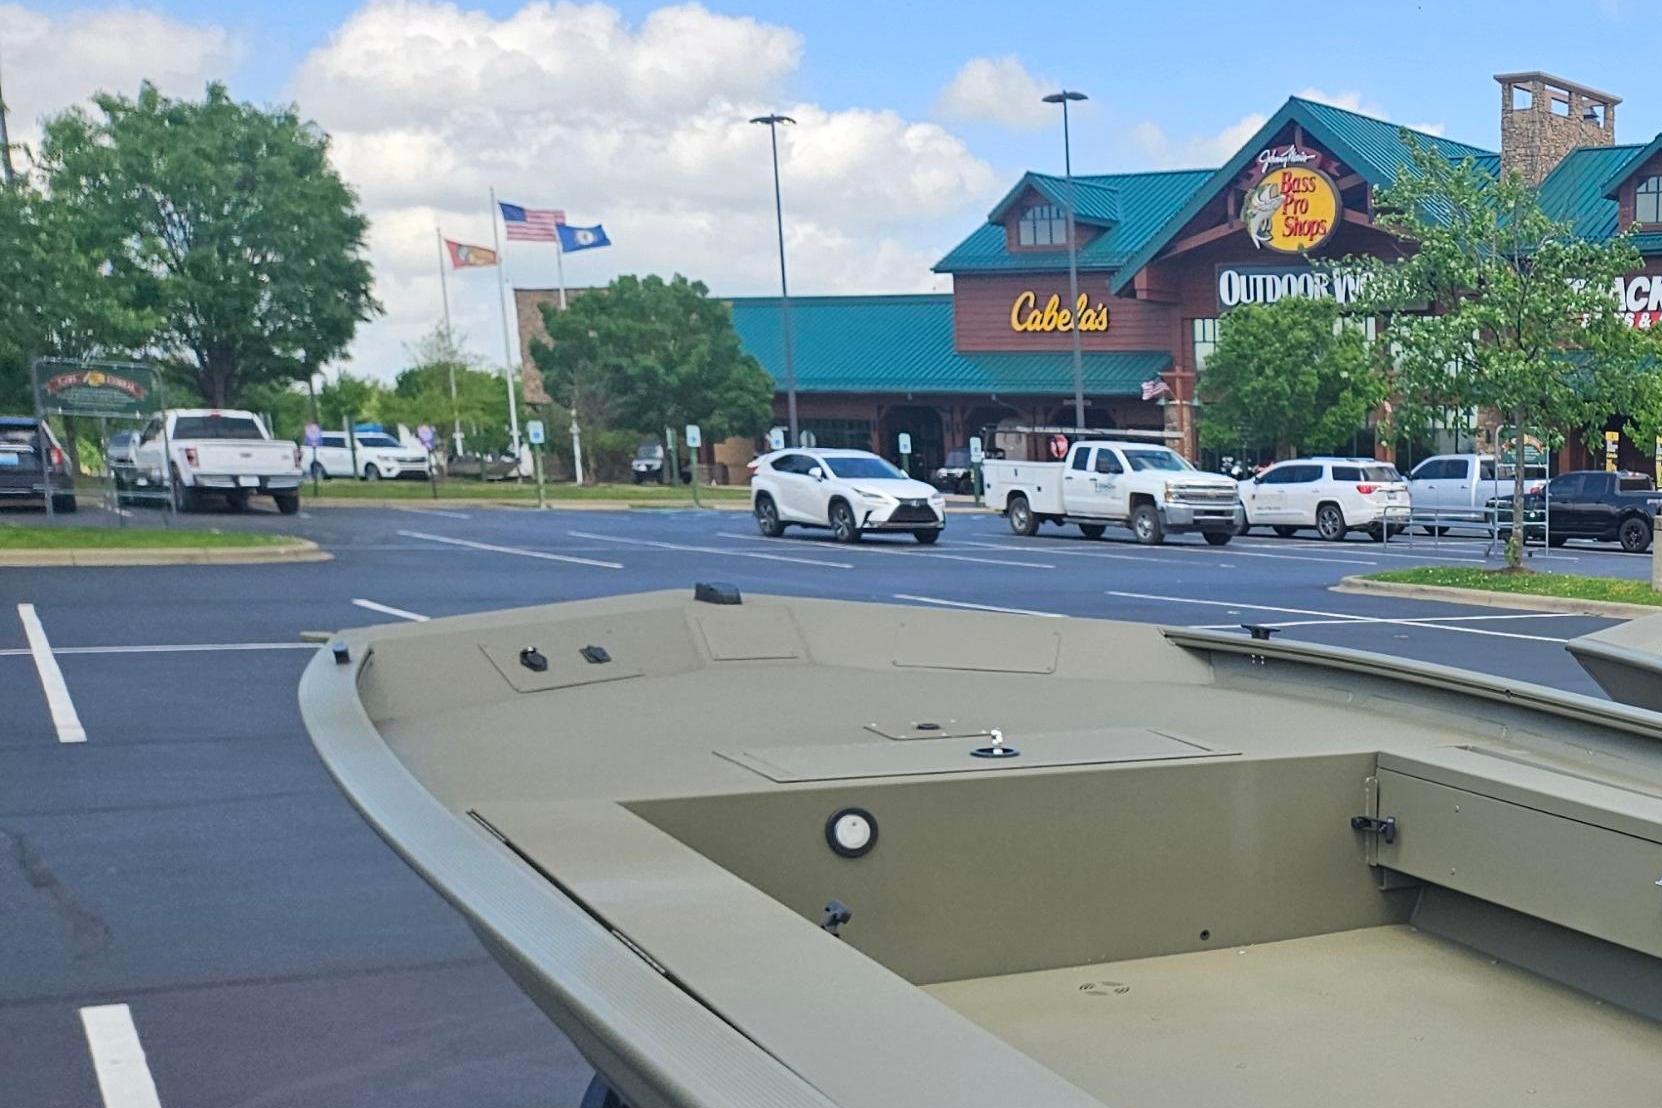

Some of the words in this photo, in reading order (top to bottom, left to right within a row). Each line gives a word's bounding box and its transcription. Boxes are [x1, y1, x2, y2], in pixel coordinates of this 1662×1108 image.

[1280, 171, 1317, 193] Bass
[1282, 195, 1309, 215] Pro
[1283, 217, 1327, 241] Shops
[1011, 291, 1108, 332] Cabela's
